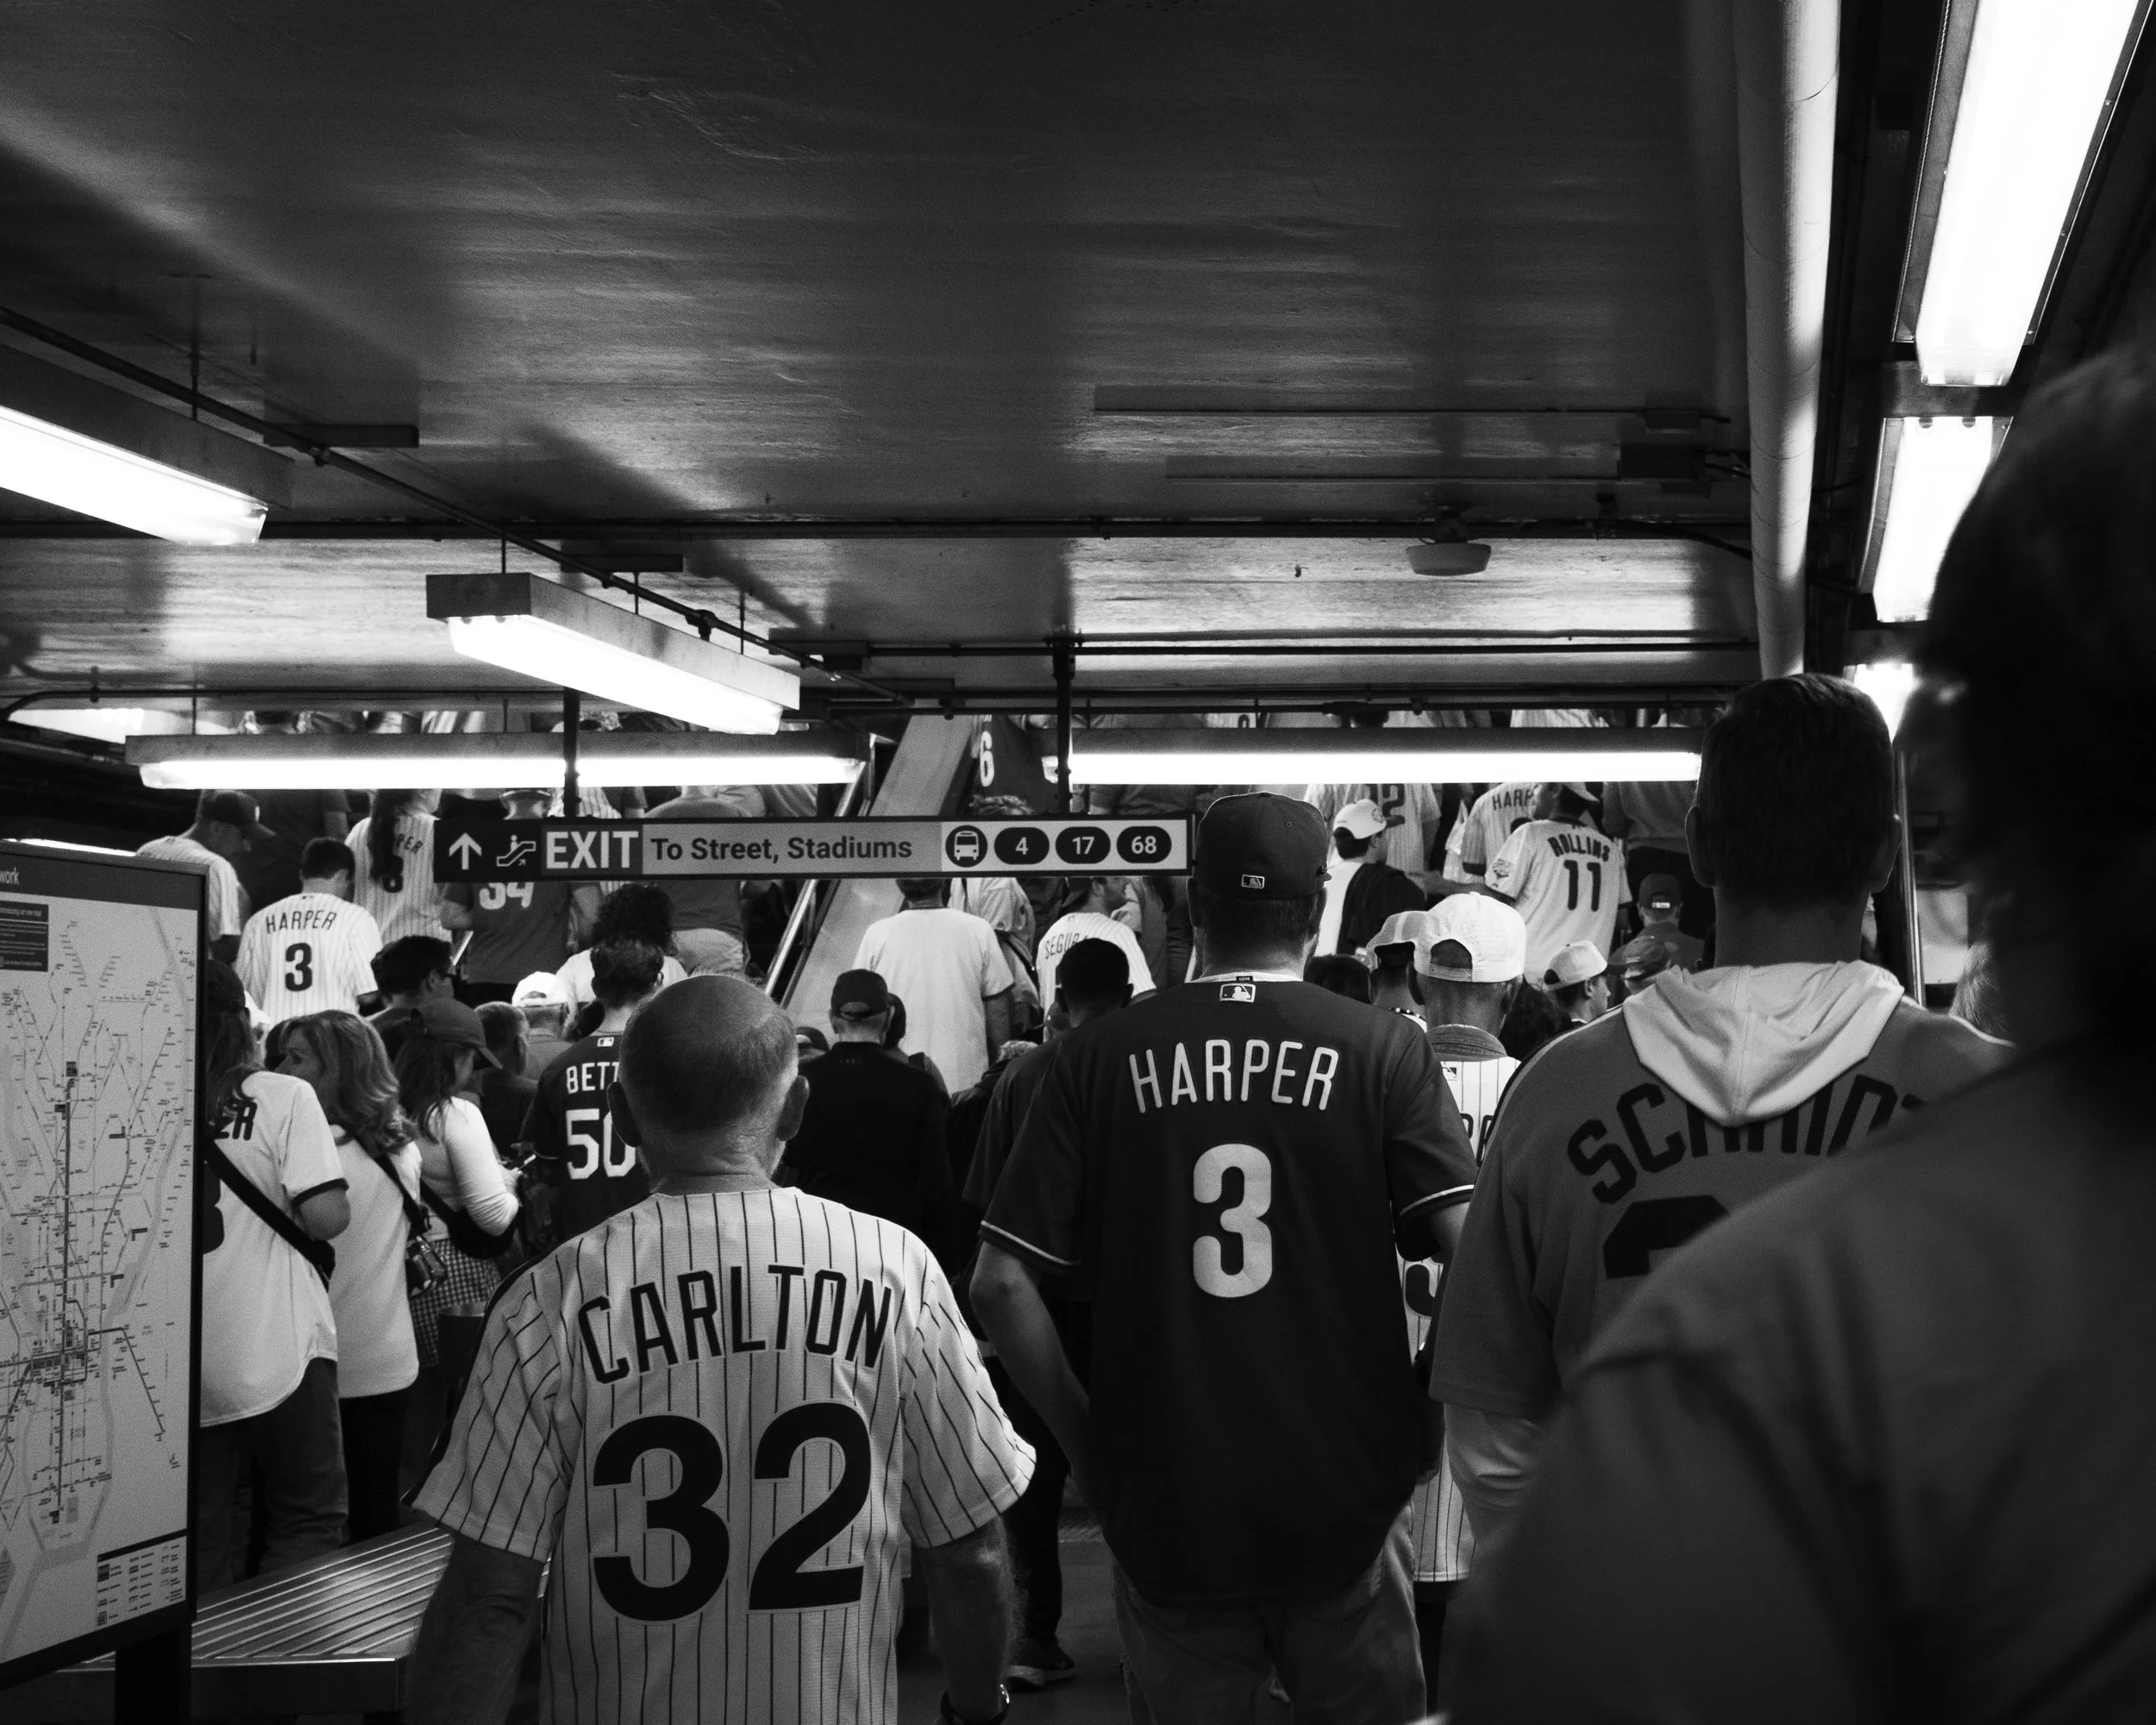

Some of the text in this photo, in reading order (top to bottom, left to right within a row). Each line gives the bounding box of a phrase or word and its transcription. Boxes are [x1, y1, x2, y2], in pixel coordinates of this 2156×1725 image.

[546, 830, 1157, 869] EXIT To Street, Stadiums 4 17 68
[1563, 859, 1601, 913] 11
[266, 909, 337, 934] HARPER
[285, 942, 312, 992] 3
[1128, 1038, 1340, 1114] HARPER
[1192, 1142, 1273, 1299] 3
[578, 1264, 892, 1385] CARLTON
[592, 1401, 872, 1622] 32
